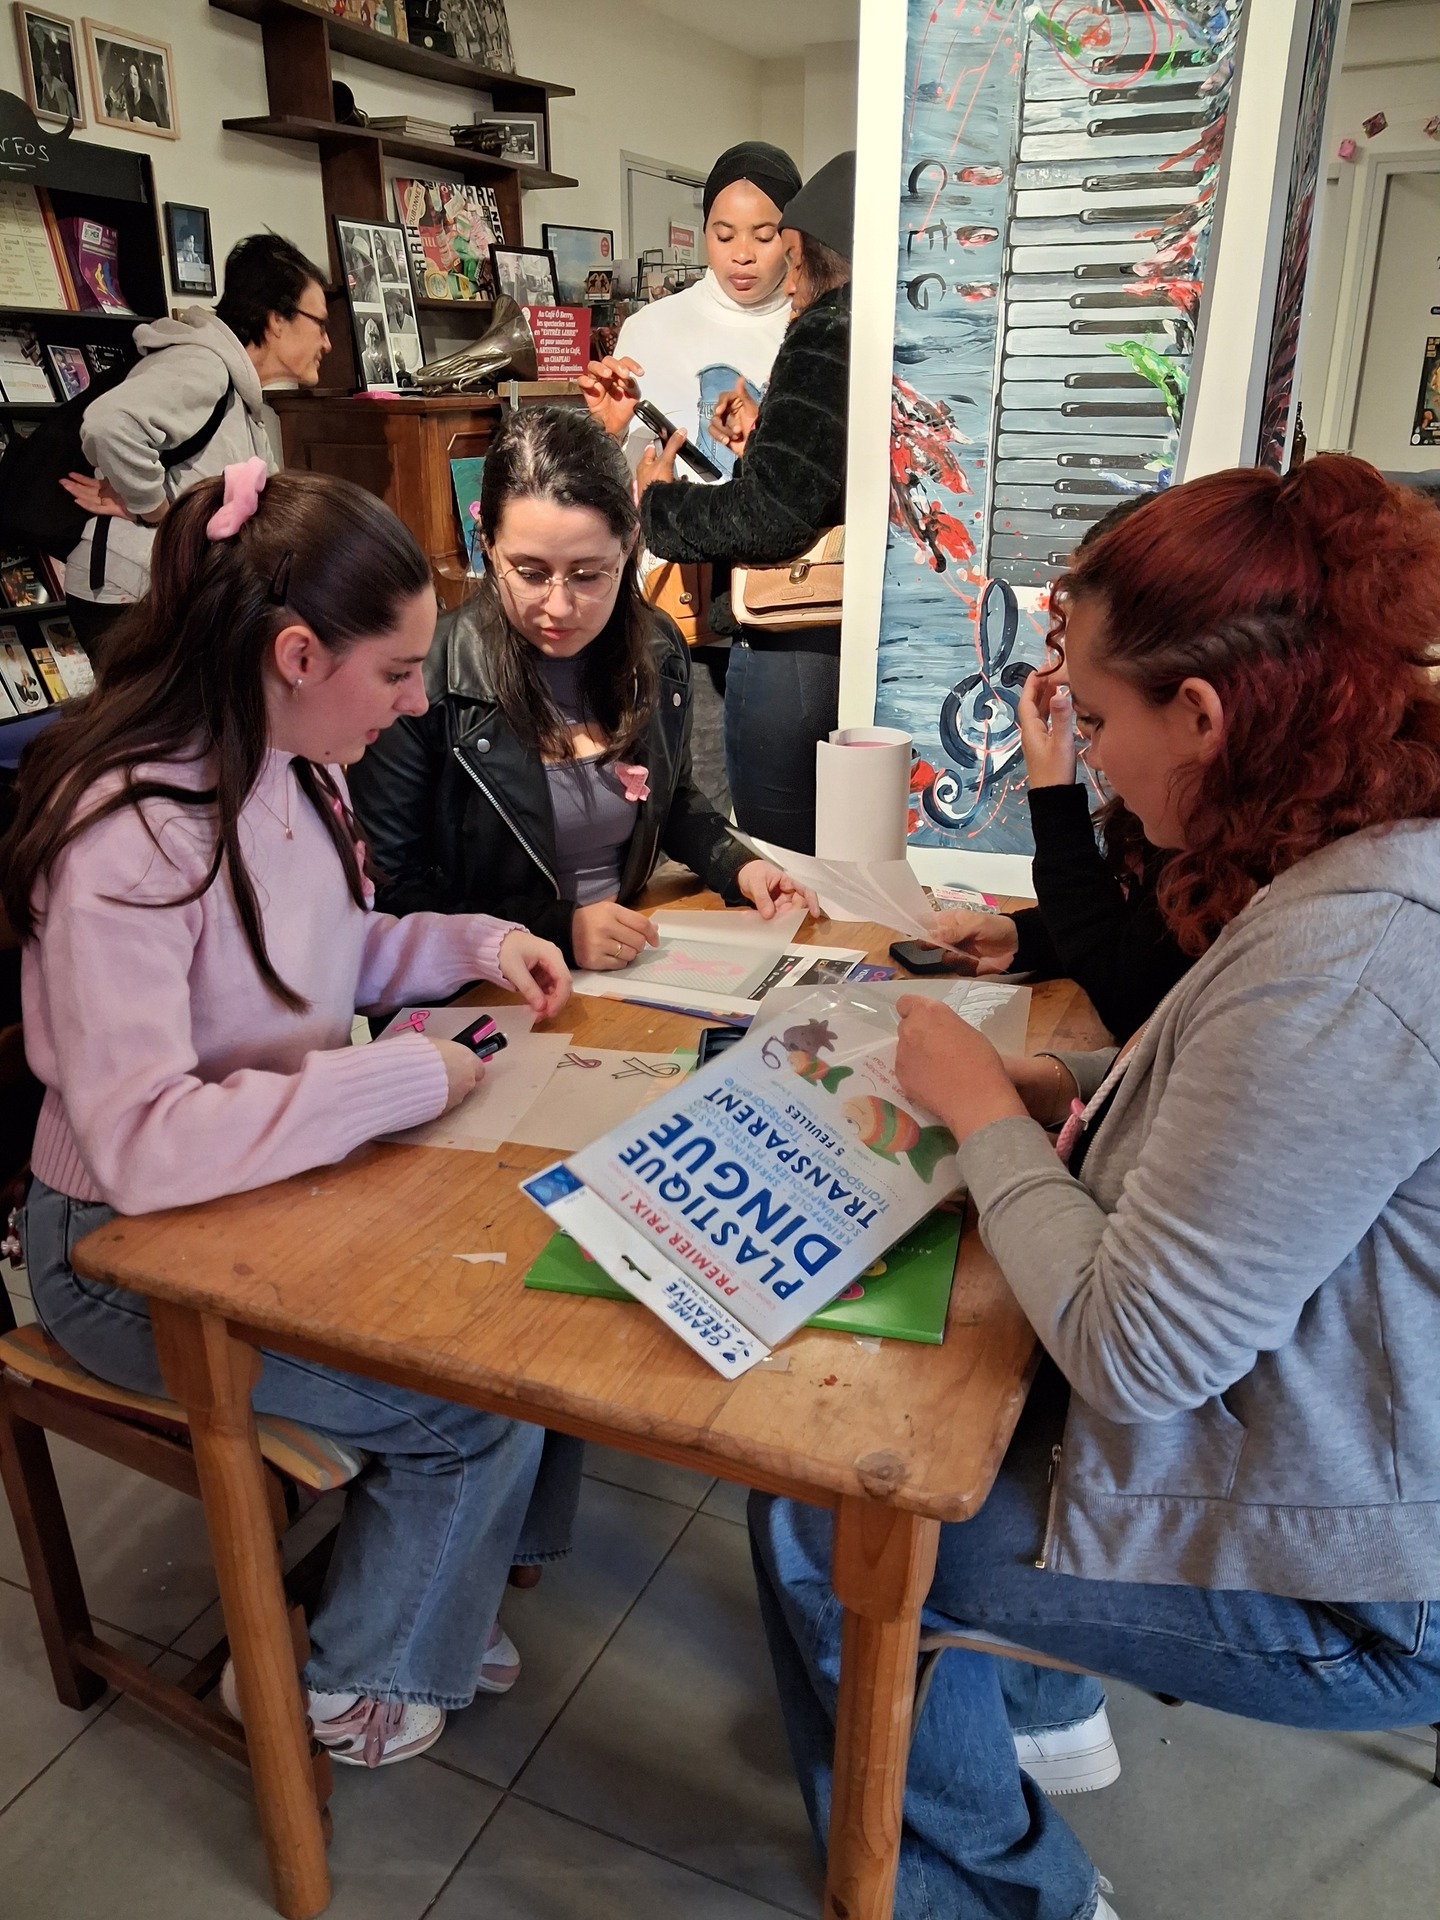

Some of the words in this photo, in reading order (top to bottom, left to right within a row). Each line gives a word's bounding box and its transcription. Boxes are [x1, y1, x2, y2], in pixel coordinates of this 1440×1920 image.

[681, 1103, 726, 1137] PLASTIC
[722, 1075, 804, 1143] Transparente
[786, 1105, 835, 1148] FEUILLES
[704, 1088, 877, 1229] TRANSPARENT
[722, 1137, 781, 1187] SHRINKING
[810, 1145, 891, 1214] Transparant
[835, 1148, 844, 1156] 5
[619, 1140, 804, 1300] PLASTIQUE
[631, 1200, 669, 1233] PRIX
[648, 1114, 842, 1276] DINGUE
[787, 1190, 853, 1246] KRIMPFOLIE
[669, 1233, 739, 1295] PREMIER
[668, 1301, 719, 1346] GRAINE
